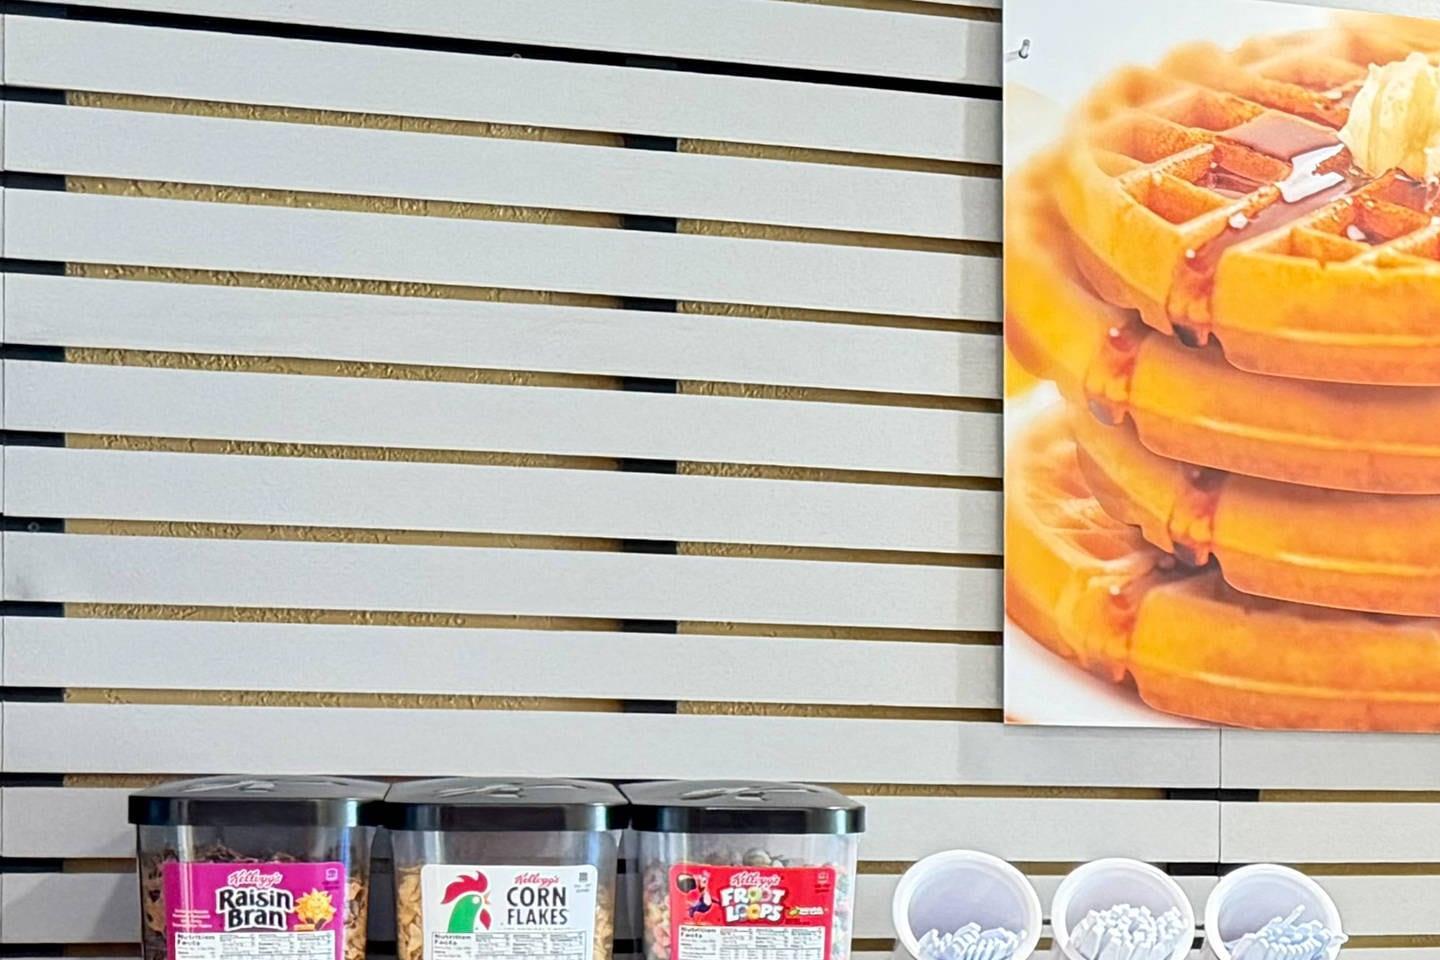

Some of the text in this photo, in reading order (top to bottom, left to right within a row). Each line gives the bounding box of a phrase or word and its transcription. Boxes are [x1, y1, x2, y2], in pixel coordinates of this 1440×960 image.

[228, 869, 283, 888] Kellogg's
[514, 873, 559, 887] Kellogg's
[730, 871, 781, 889] Kellogg's
[218, 888, 292, 910] Raisin
[506, 886, 566, 907] CORN
[720, 887, 785, 907] FROOT
[227, 909, 284, 929] Bran
[507, 909, 569, 925] FLAKES
[725, 904, 784, 922] LOOPS
